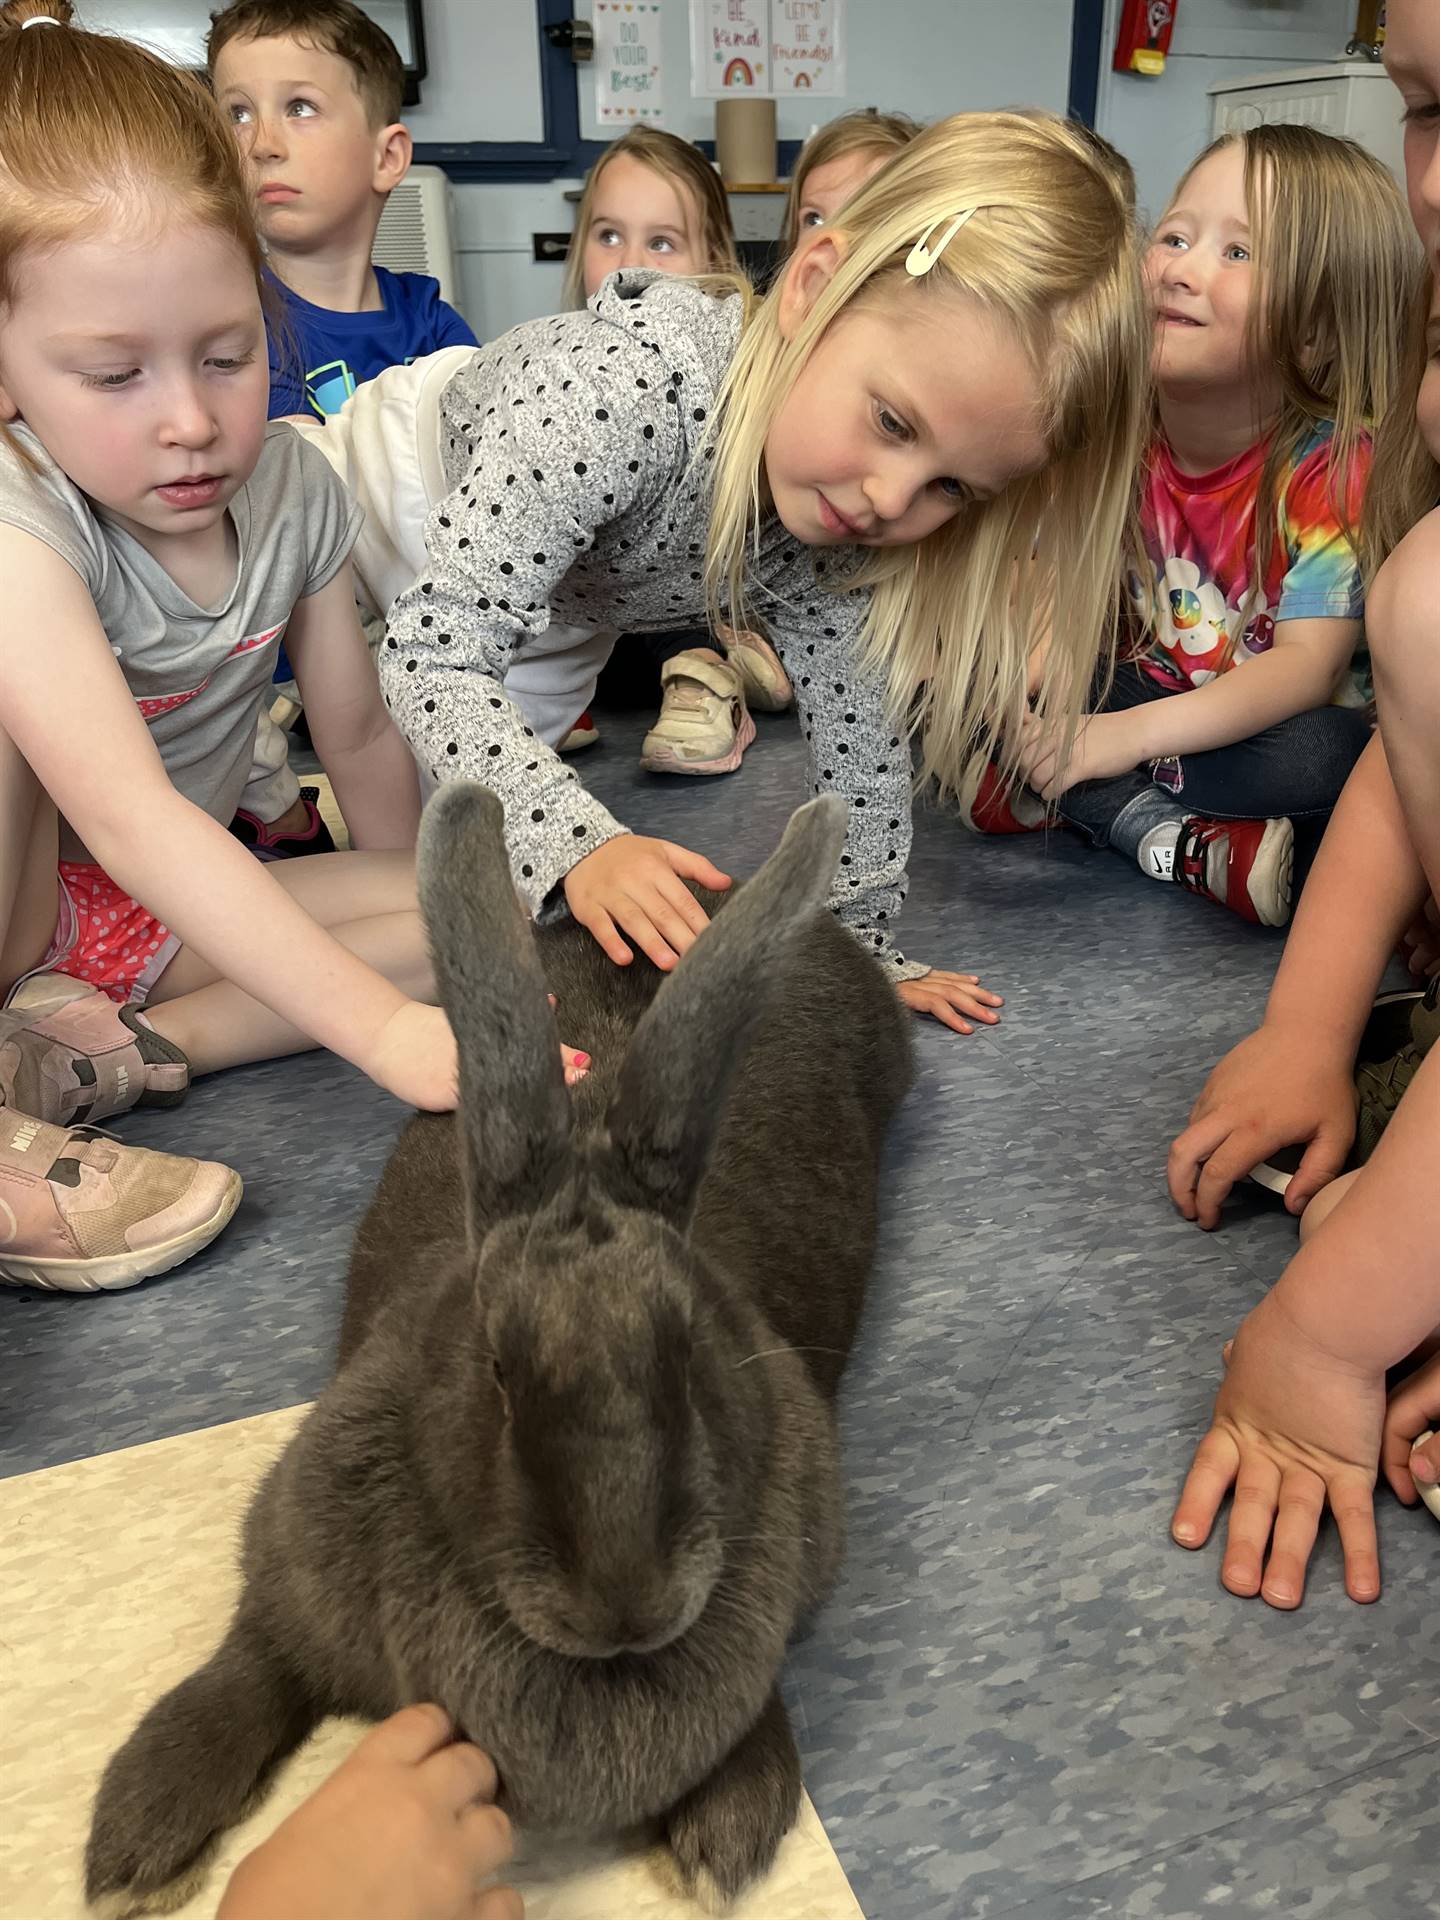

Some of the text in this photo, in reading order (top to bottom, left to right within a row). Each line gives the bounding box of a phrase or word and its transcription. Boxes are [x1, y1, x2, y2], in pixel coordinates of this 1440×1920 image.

[620, 22, 639, 43] DO
[613, 46, 648, 66] YOUR
[1164, 850, 1172, 873] AIR
